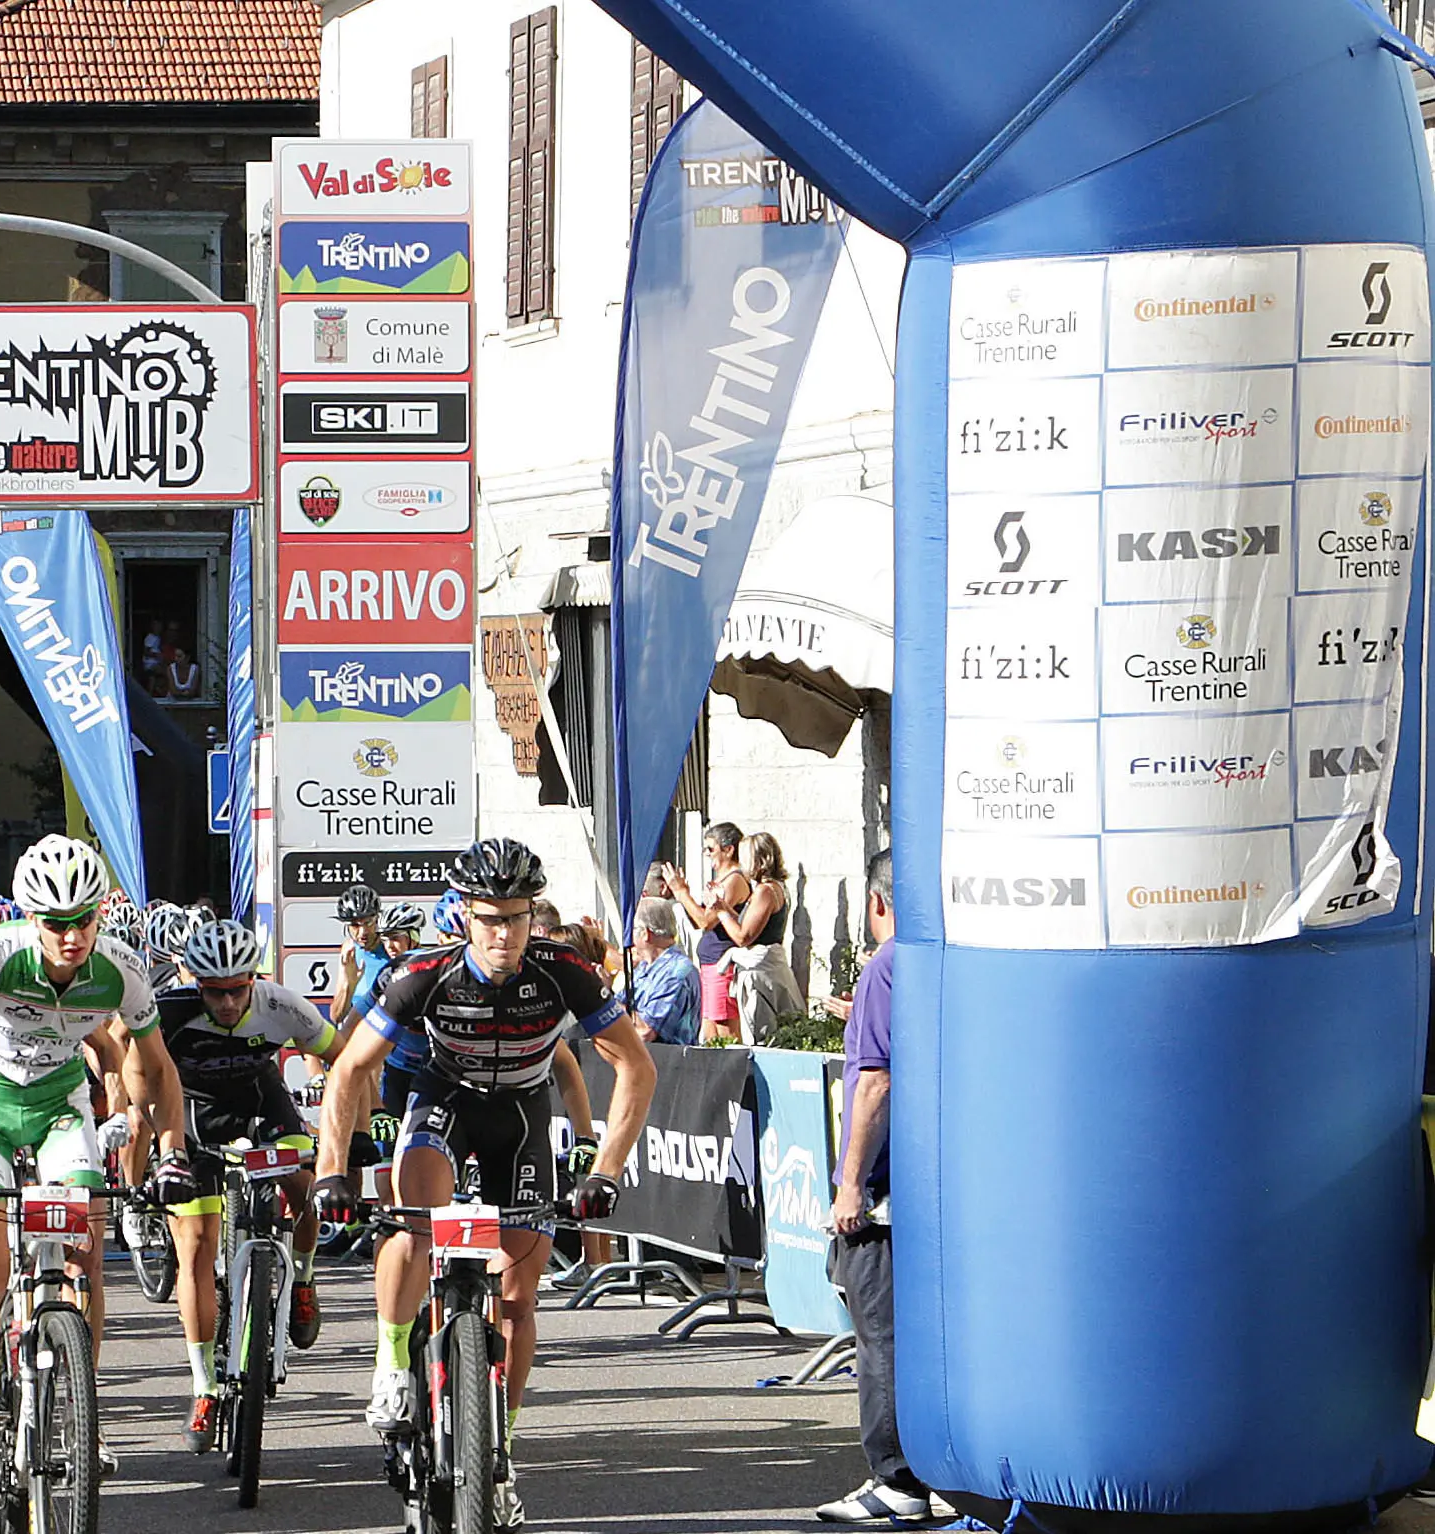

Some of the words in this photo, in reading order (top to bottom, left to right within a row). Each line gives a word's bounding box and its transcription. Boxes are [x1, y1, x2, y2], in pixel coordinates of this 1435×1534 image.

[298, 162, 350, 200] Val
[353, 174, 375, 194] di
[317, 239, 431, 271] TRENTINO
[1133, 293, 1256, 322] Continental
[366, 318, 450, 336] Comune
[960, 316, 1013, 341] Casse
[1018, 311, 1077, 335] Rurali
[974, 342, 1058, 364] Trentine
[1327, 331, 1414, 349] SCOTT
[372, 346, 390, 364] di
[396, 346, 444, 364] Malè
[319, 407, 433, 429] SKI.IT
[629, 267, 795, 577] TRENTINO
[1120, 412, 1245, 432] Friliver
[1314, 415, 1405, 440] Continental
[11, 440, 78, 472] nature
[82, 392, 200, 487] MTB
[1205, 418, 1258, 446] Sport
[377, 489, 427, 498] FAMIGLIA
[1318, 528, 1377, 555] Casse
[283, 569, 466, 621] ARRIVO
[965, 578, 1068, 597] SCOTT
[1124, 653, 1197, 680] Casse
[1202, 648, 1266, 674] Rurali
[308, 670, 443, 707] TRENTINO
[1145, 677, 1248, 703] Trentine
[1130, 755, 1254, 775] Friliver
[296, 780, 377, 807] Casse
[383, 780, 456, 806] Rurali
[957, 771, 1011, 795] Casse
[1016, 771, 1074, 794] Rurali
[972, 796, 1055, 821] Trentine
[319, 809, 434, 835] Trentine
[1126, 881, 1248, 909] Continental
[45, 1204, 67, 1229] 10
[458, 1221, 473, 1246] 7
